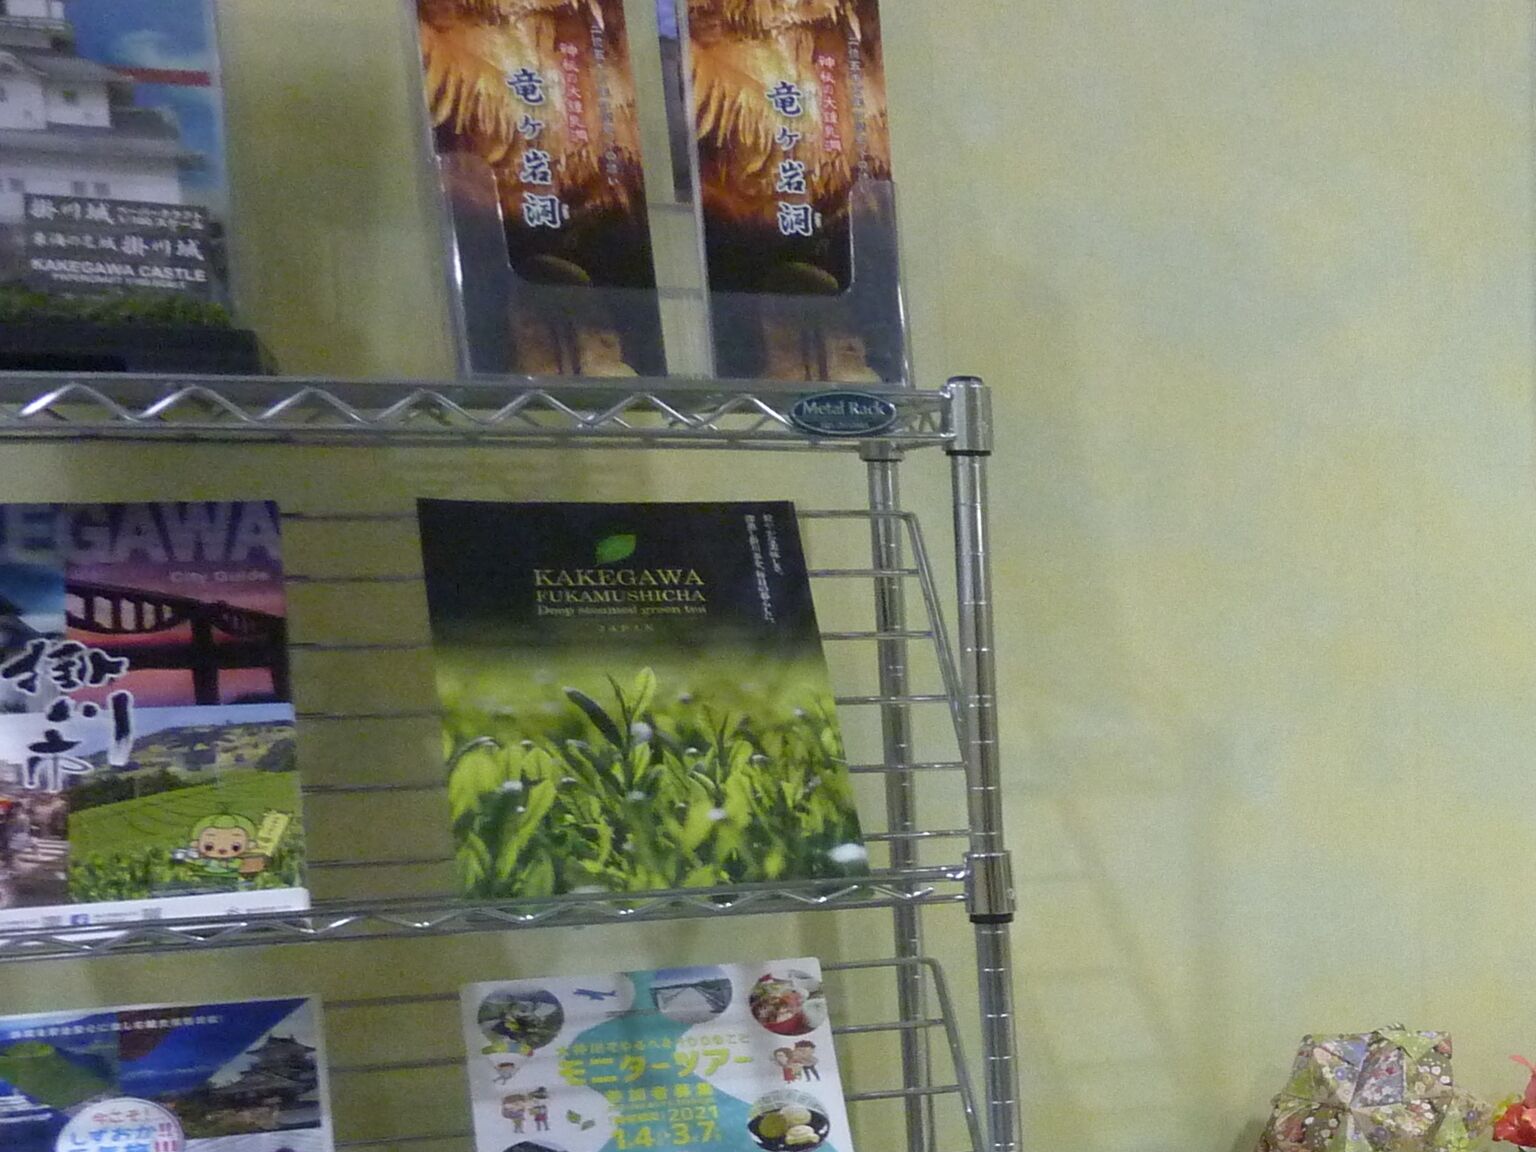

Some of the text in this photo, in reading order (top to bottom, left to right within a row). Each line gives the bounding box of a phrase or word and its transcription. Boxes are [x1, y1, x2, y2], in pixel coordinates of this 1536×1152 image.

[138, 265, 207, 283] CASTLE
[848, 401, 887, 417] Rack
[533, 568, 705, 587] KAKEGAWA
[536, 589, 707, 603] FUKAMUSHICHA
[558, 1046, 754, 1088] モニターツアー
[667, 1104, 719, 1123] 2021
